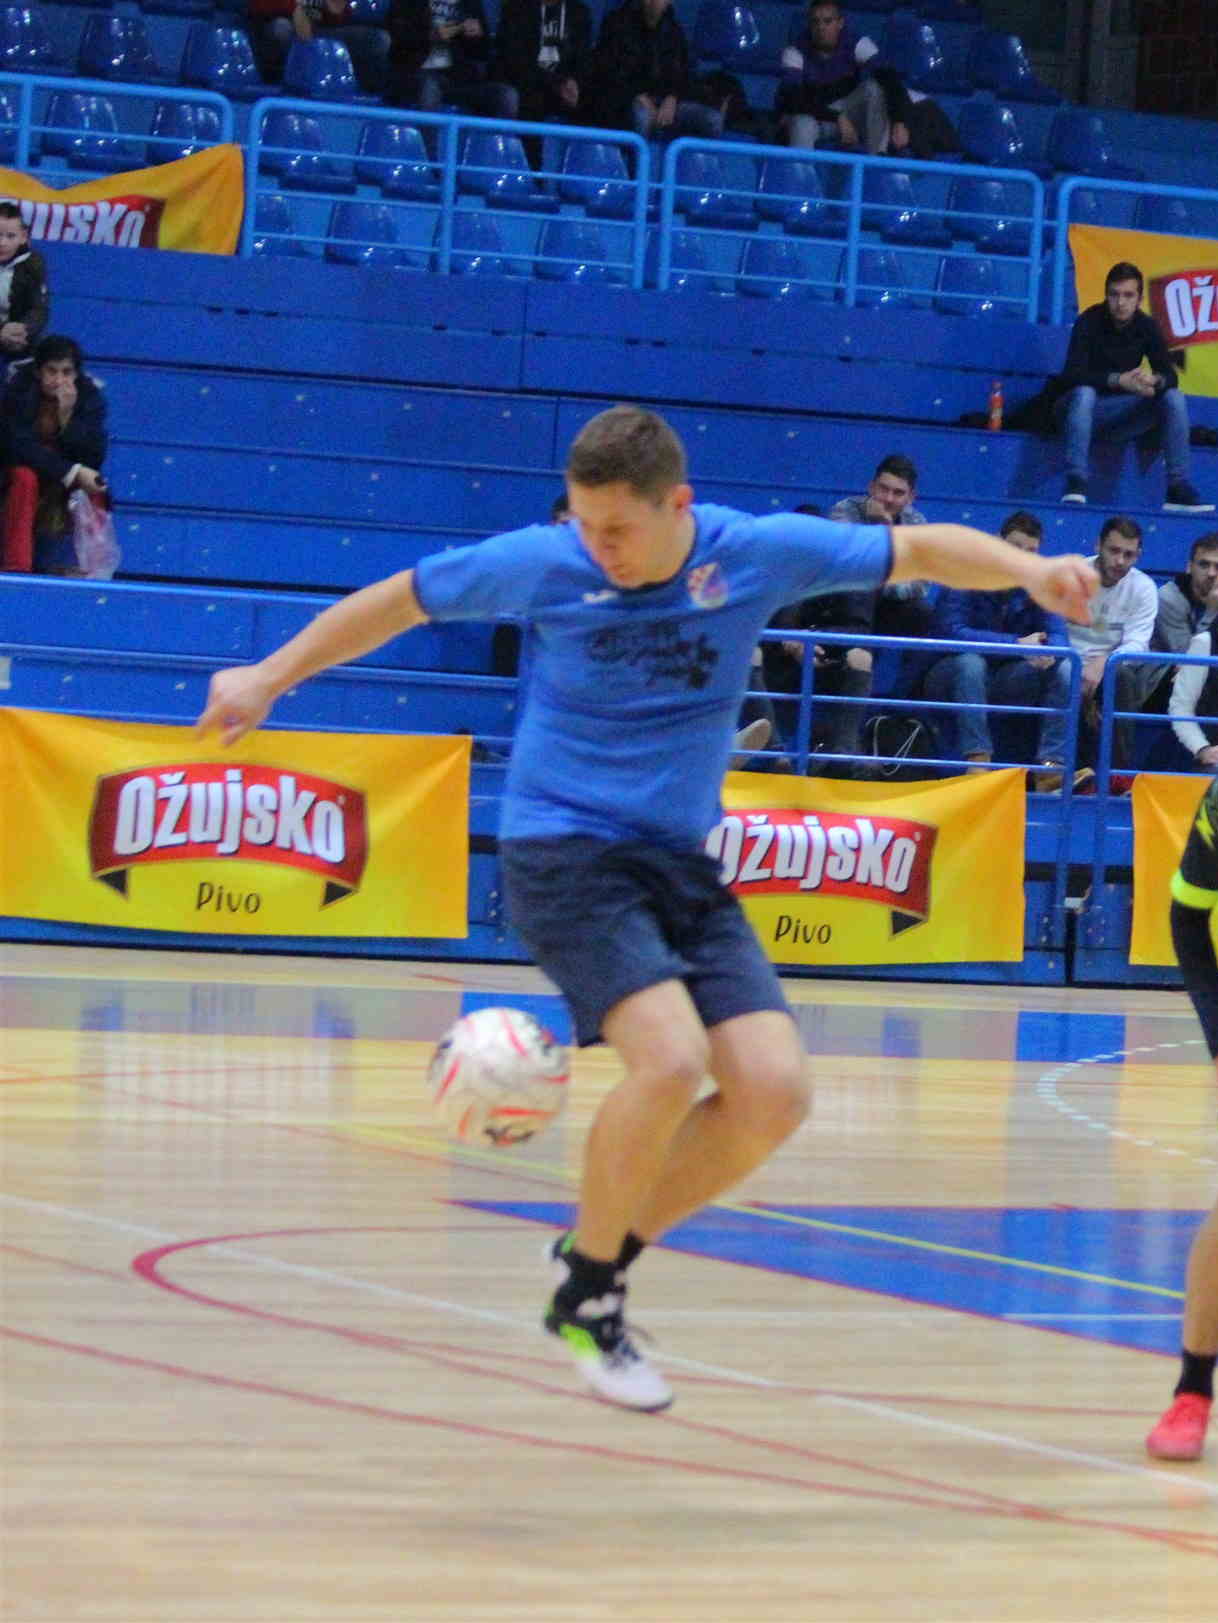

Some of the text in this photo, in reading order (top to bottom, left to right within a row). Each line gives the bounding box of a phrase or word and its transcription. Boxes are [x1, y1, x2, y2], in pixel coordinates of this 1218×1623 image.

[113, 768, 346, 864] Ožujsko
[704, 814, 919, 894] Ožujsko
[194, 881, 261, 914] Pivo
[773, 914, 832, 945] Pivo
